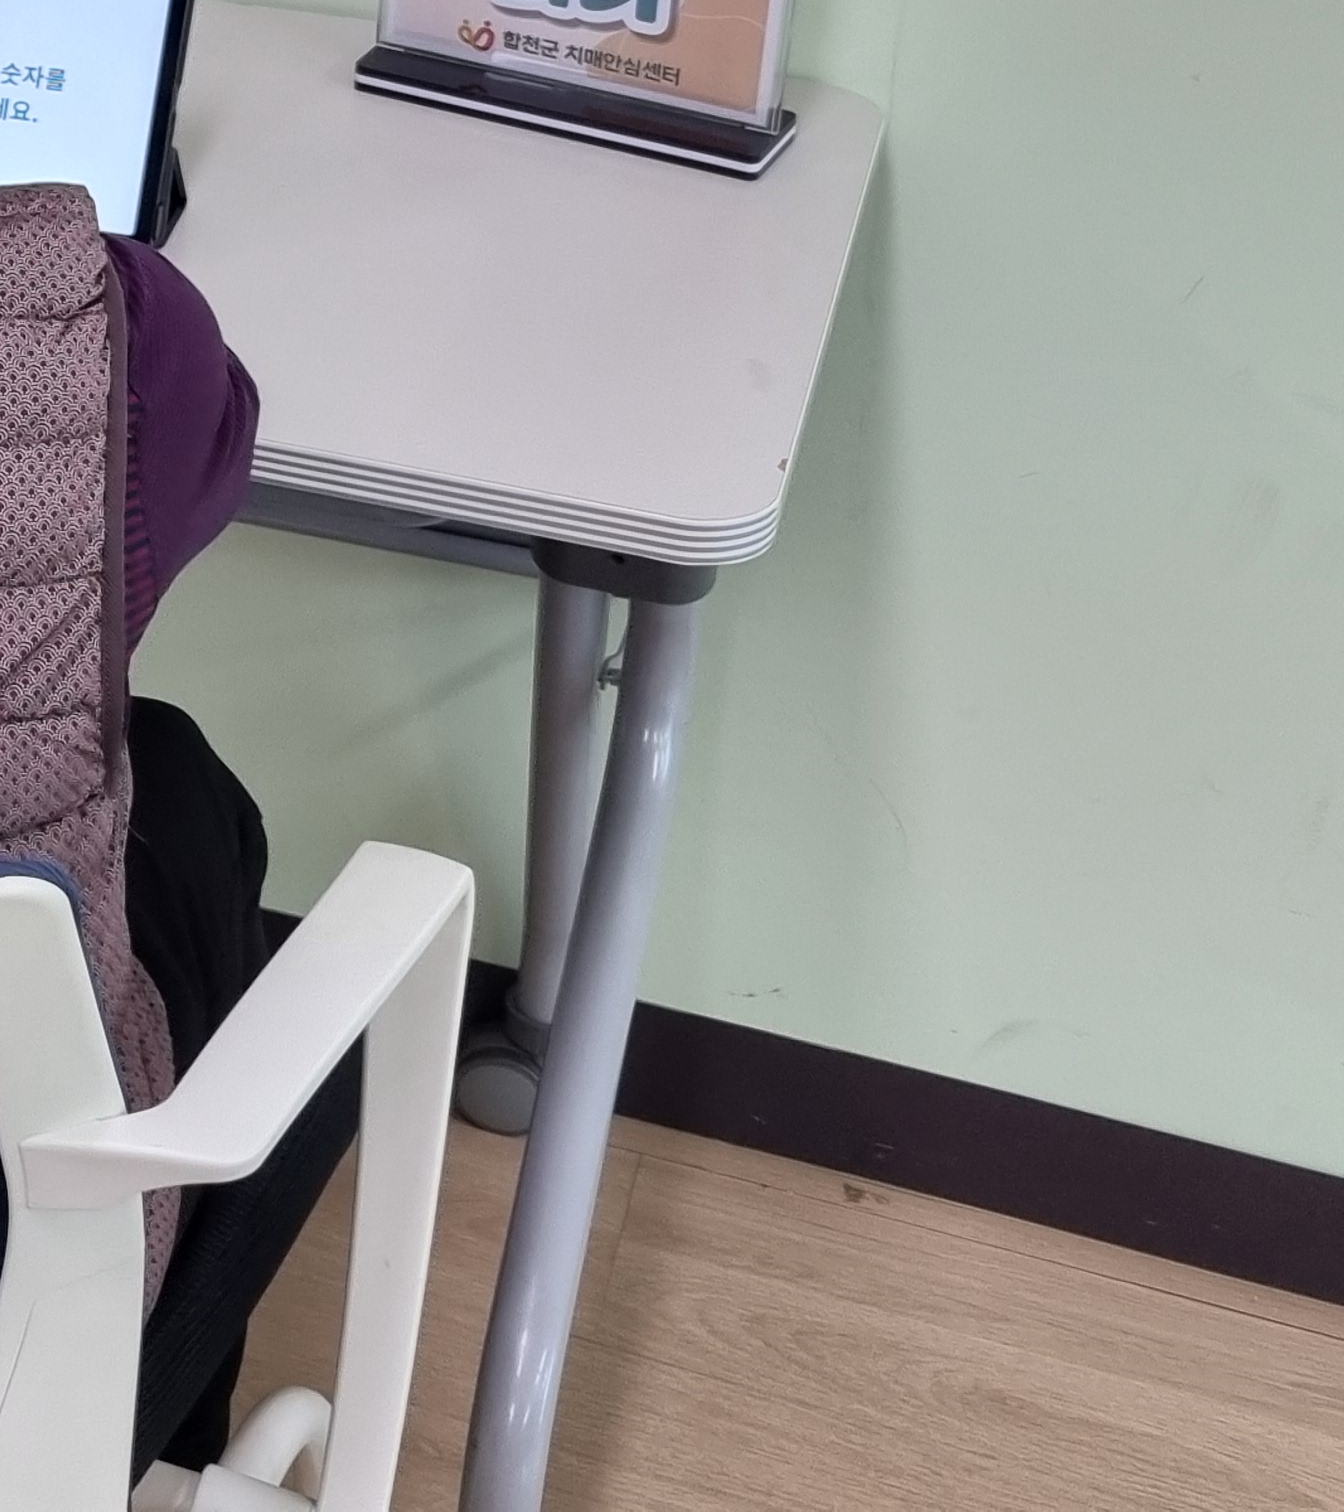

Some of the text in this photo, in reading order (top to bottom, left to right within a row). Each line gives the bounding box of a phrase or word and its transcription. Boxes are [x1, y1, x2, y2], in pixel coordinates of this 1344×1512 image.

[0, 62, 66, 92] 숫자를
[502, 29, 682, 87] 합천군 치매안심센터
